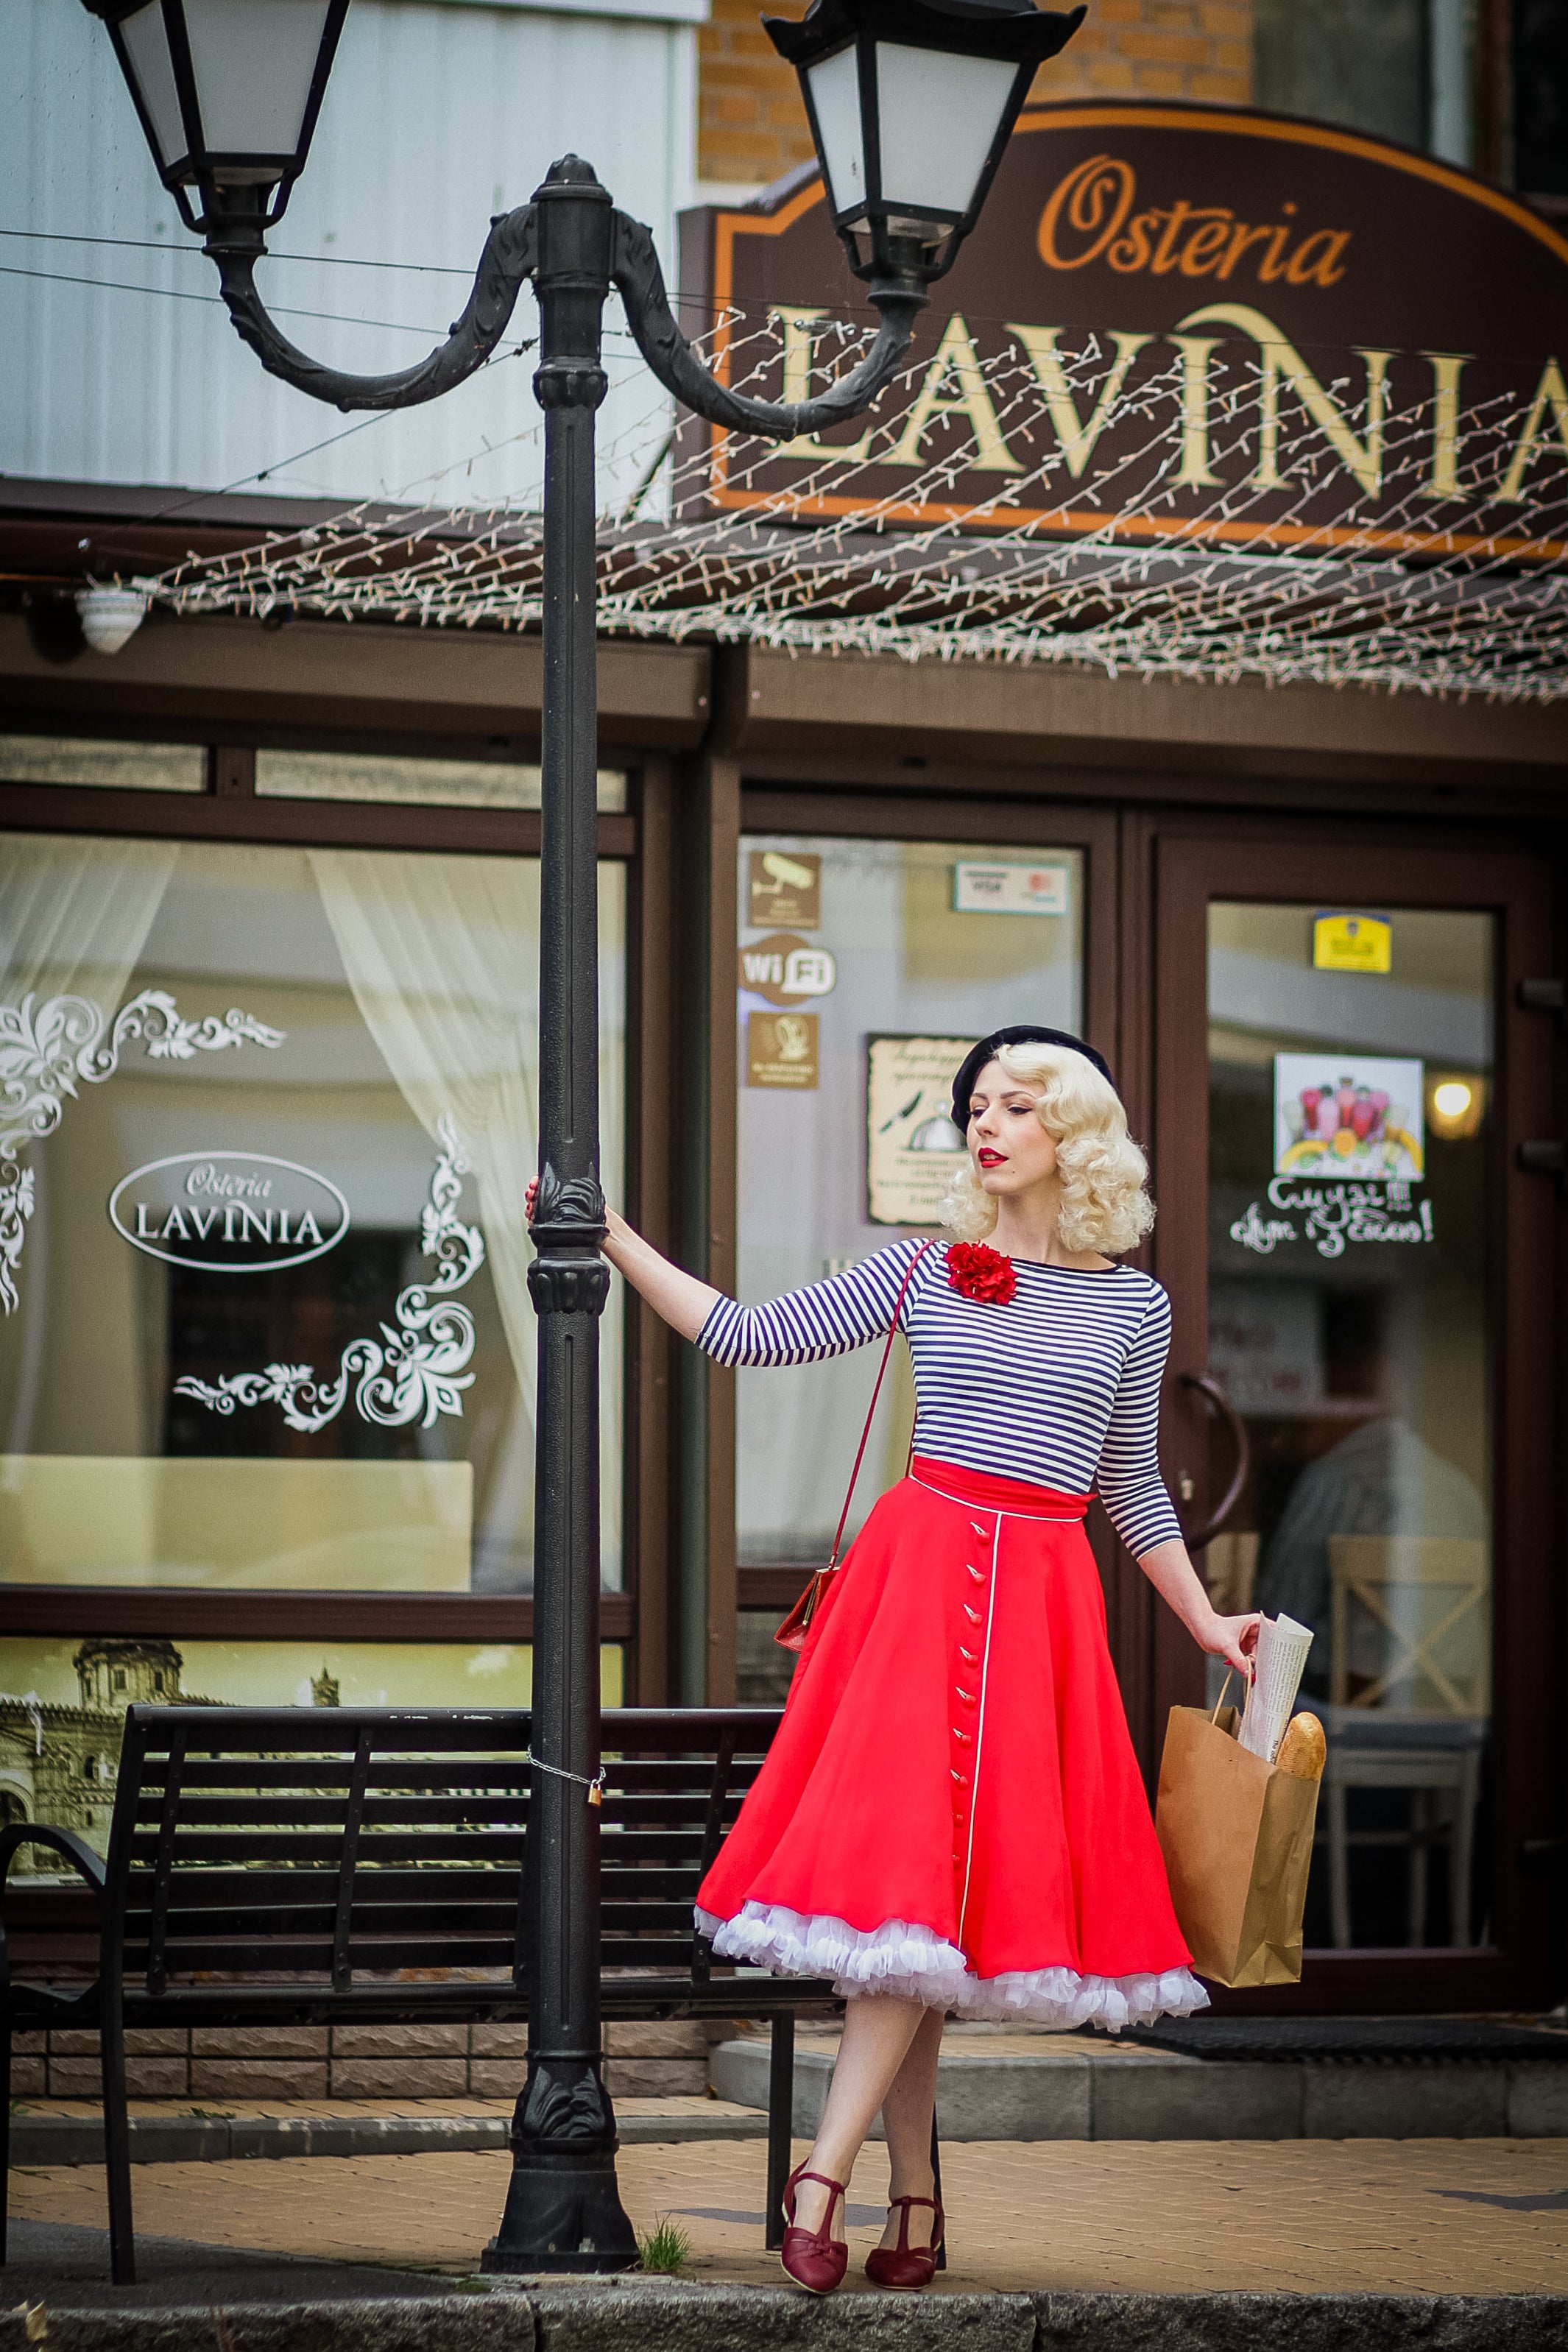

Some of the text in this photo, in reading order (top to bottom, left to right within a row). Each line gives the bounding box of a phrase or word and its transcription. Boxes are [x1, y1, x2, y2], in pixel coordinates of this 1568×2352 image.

[1036, 154, 1353, 287] Osteria
[762, 303, 1568, 504] LAVINIA
[135, 1199, 325, 1245] LAVINIA
[186, 1162, 273, 1197] Osteria
